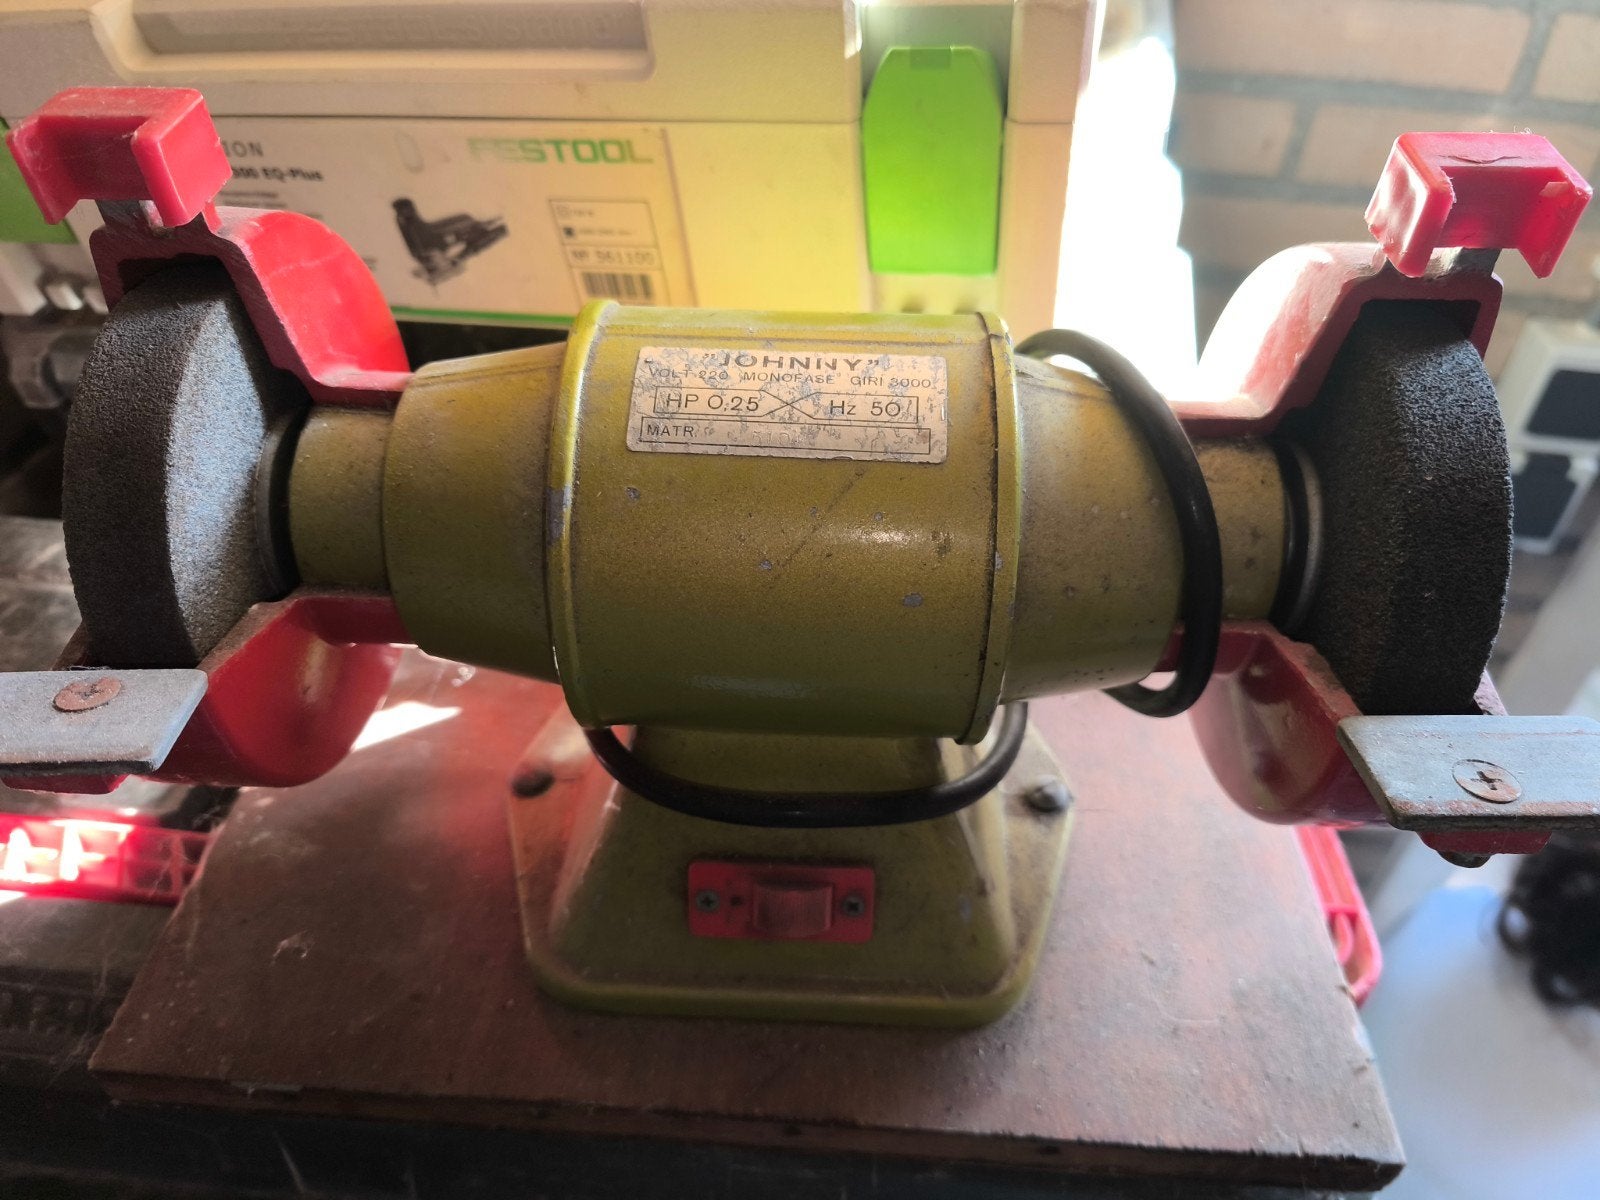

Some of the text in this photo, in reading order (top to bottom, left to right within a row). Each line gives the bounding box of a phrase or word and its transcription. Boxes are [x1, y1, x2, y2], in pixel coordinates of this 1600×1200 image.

[467, 137, 654, 164] FESTOOL
[649, 367, 932, 388] VOLT 220 MONOFASE GIRI 3000
[666, 393, 700, 409] HP
[830, 400, 901, 417] Hz 50
